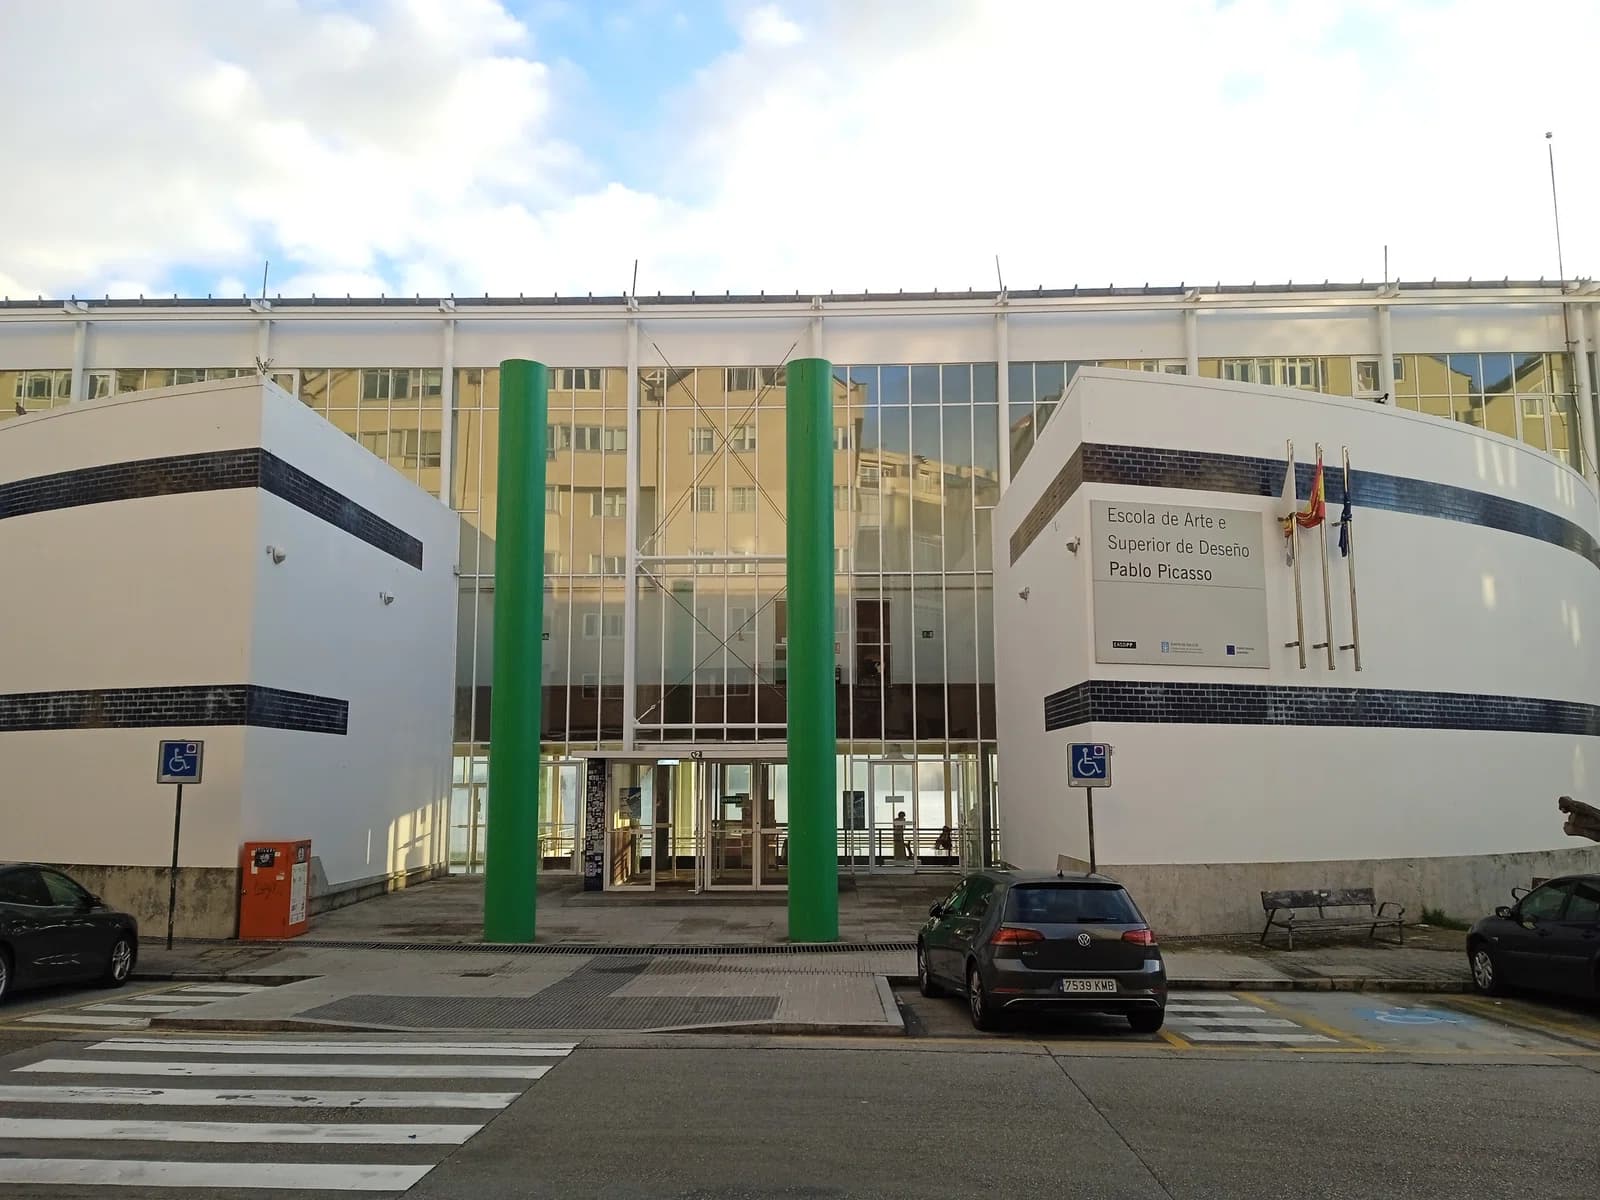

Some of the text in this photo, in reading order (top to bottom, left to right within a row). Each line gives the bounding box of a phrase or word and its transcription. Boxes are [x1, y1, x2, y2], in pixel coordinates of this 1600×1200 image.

[1108, 507, 1227, 530] Escola de Arte e
[1108, 534, 1250, 558] Superior de Deseño
[1109, 561, 1212, 581] Pablo Picasso
[1065, 980, 1114, 991] 7539 KMB
